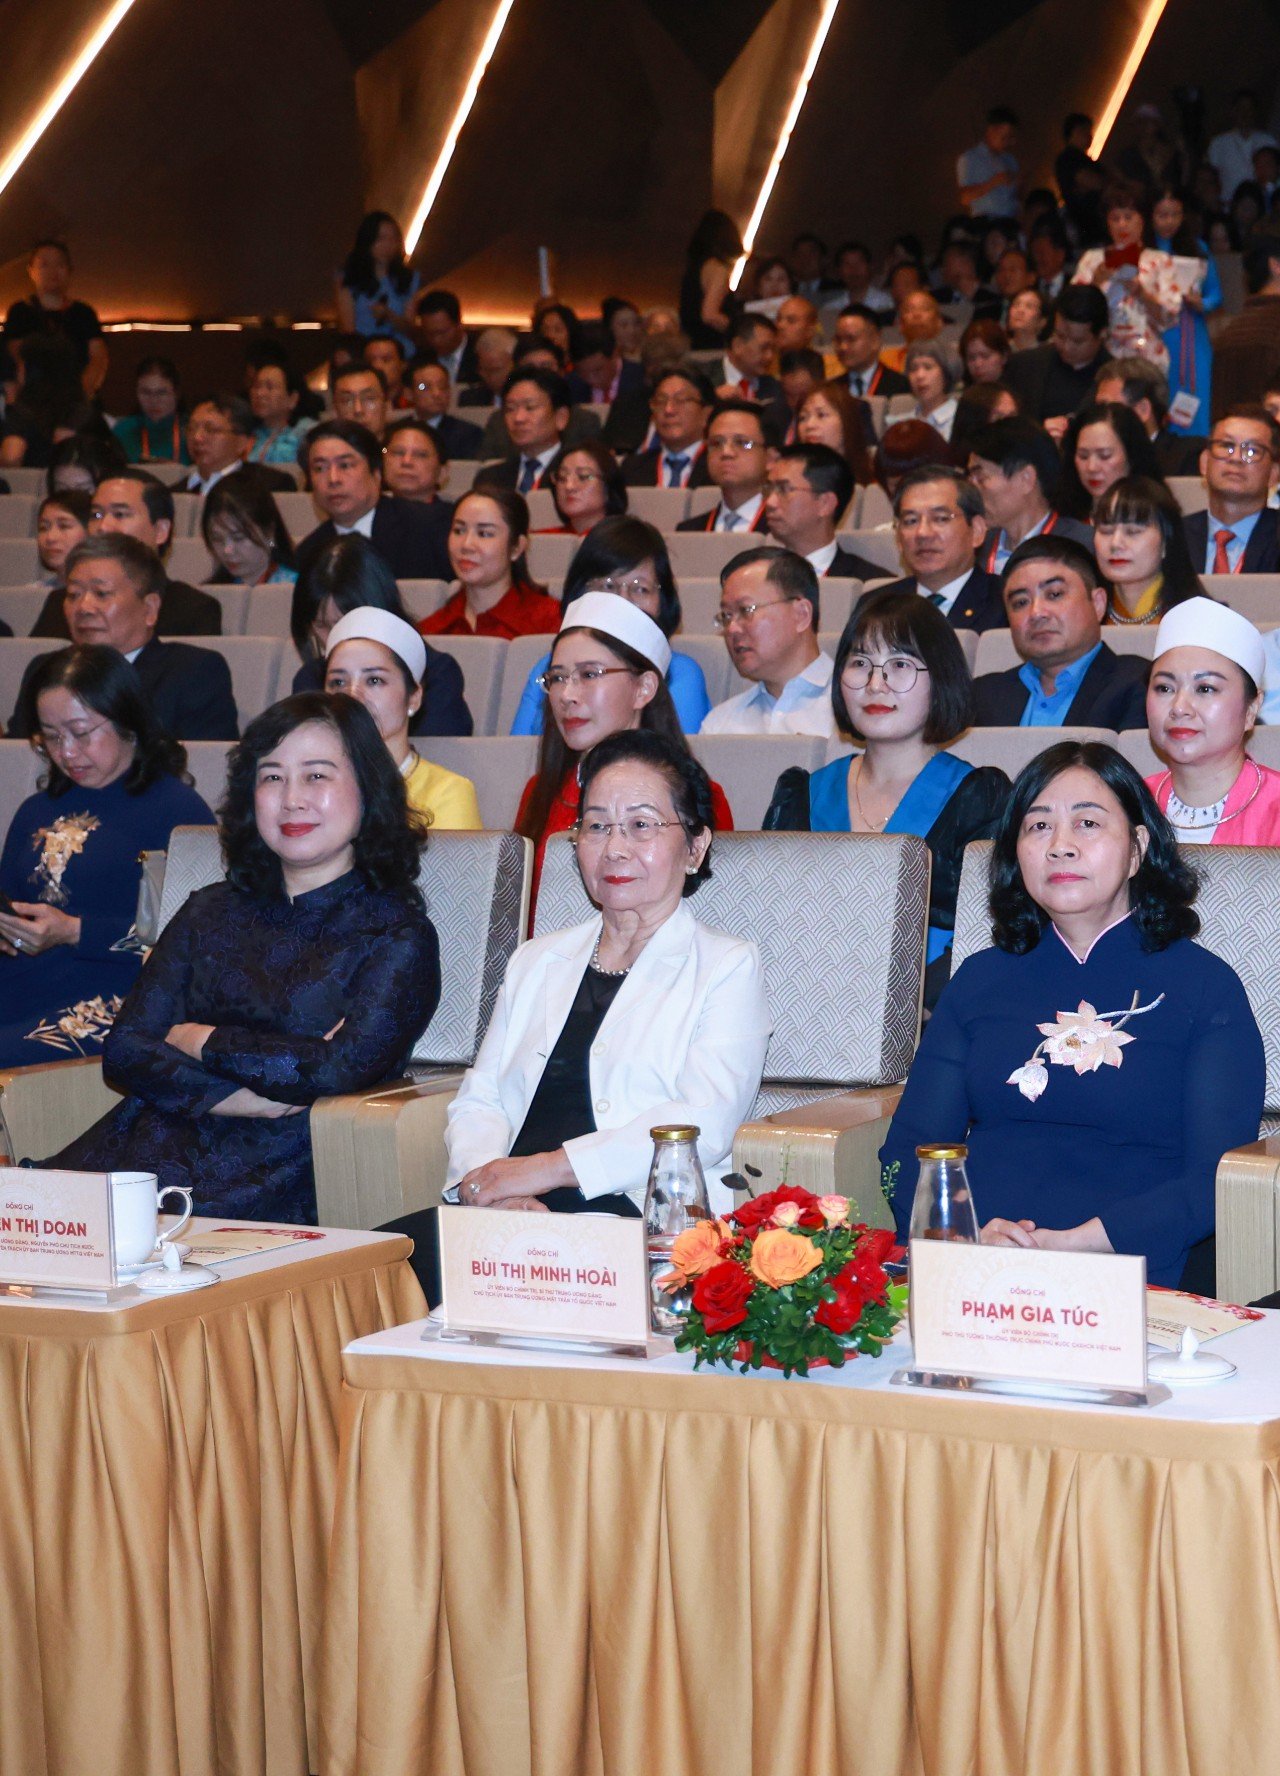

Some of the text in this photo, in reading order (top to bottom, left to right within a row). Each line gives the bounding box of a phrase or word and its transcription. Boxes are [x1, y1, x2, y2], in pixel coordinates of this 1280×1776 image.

[16, 1218, 38, 1237] THỊ
[44, 1220, 86, 1236] DOAN
[472, 1257, 616, 1286] BÙI THỊ MINH HOÀI
[962, 1300, 1098, 1327] PHẠM GIA TÚC
